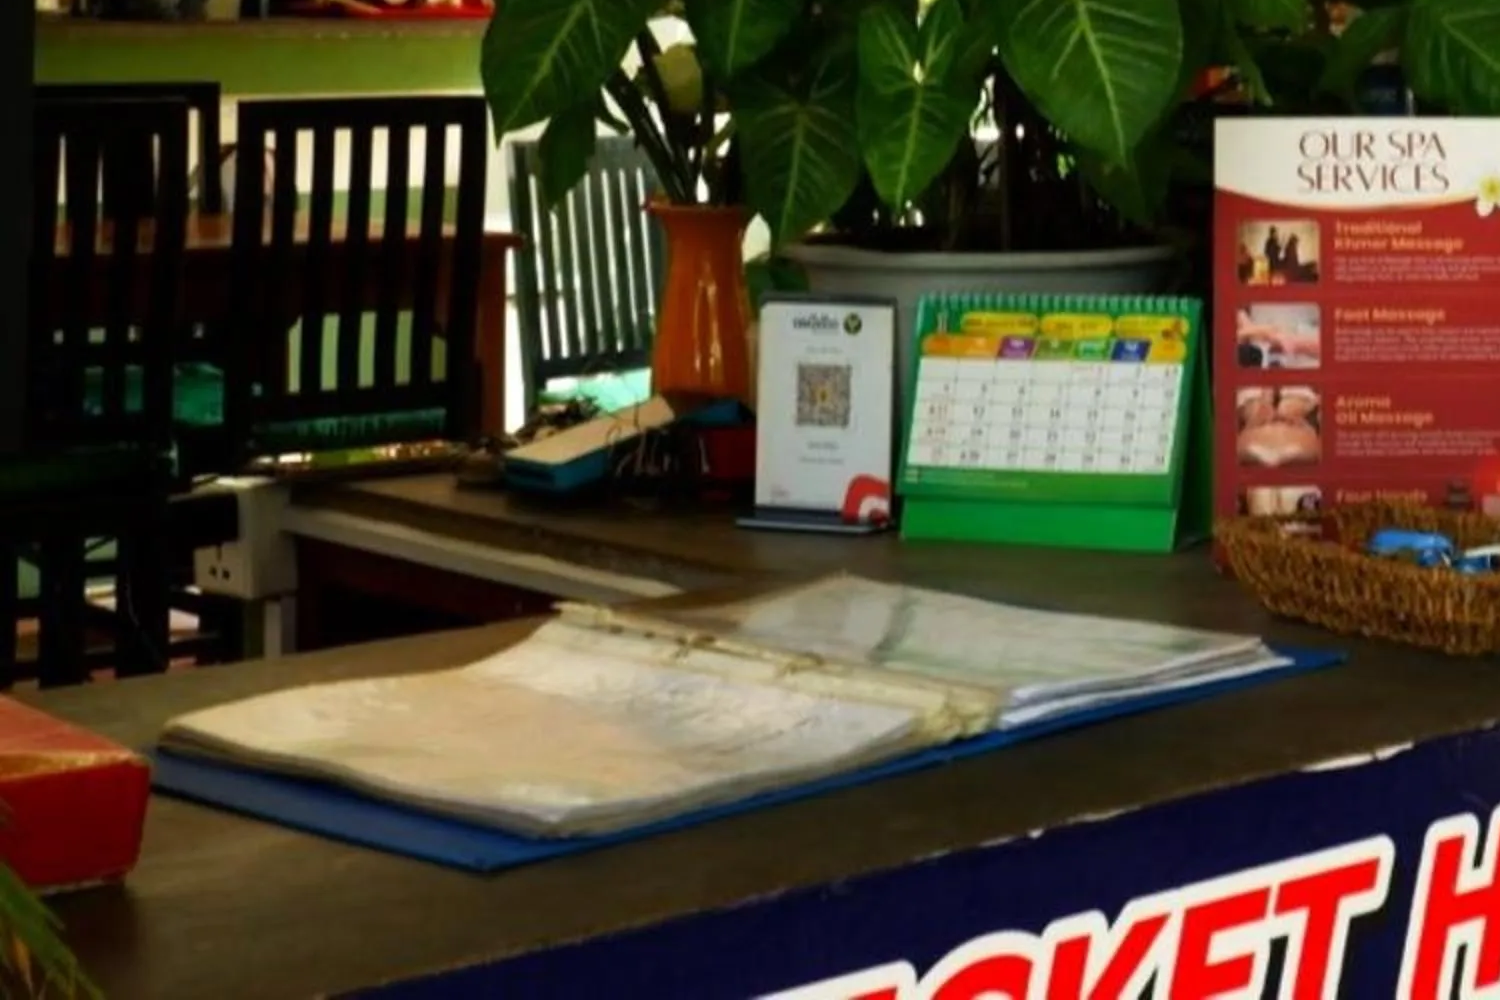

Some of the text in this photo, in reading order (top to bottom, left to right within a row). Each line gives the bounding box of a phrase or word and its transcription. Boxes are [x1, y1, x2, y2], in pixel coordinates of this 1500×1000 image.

[1298, 128, 1447, 161] OUR SPA
[1297, 162, 1450, 192] SERVICES
